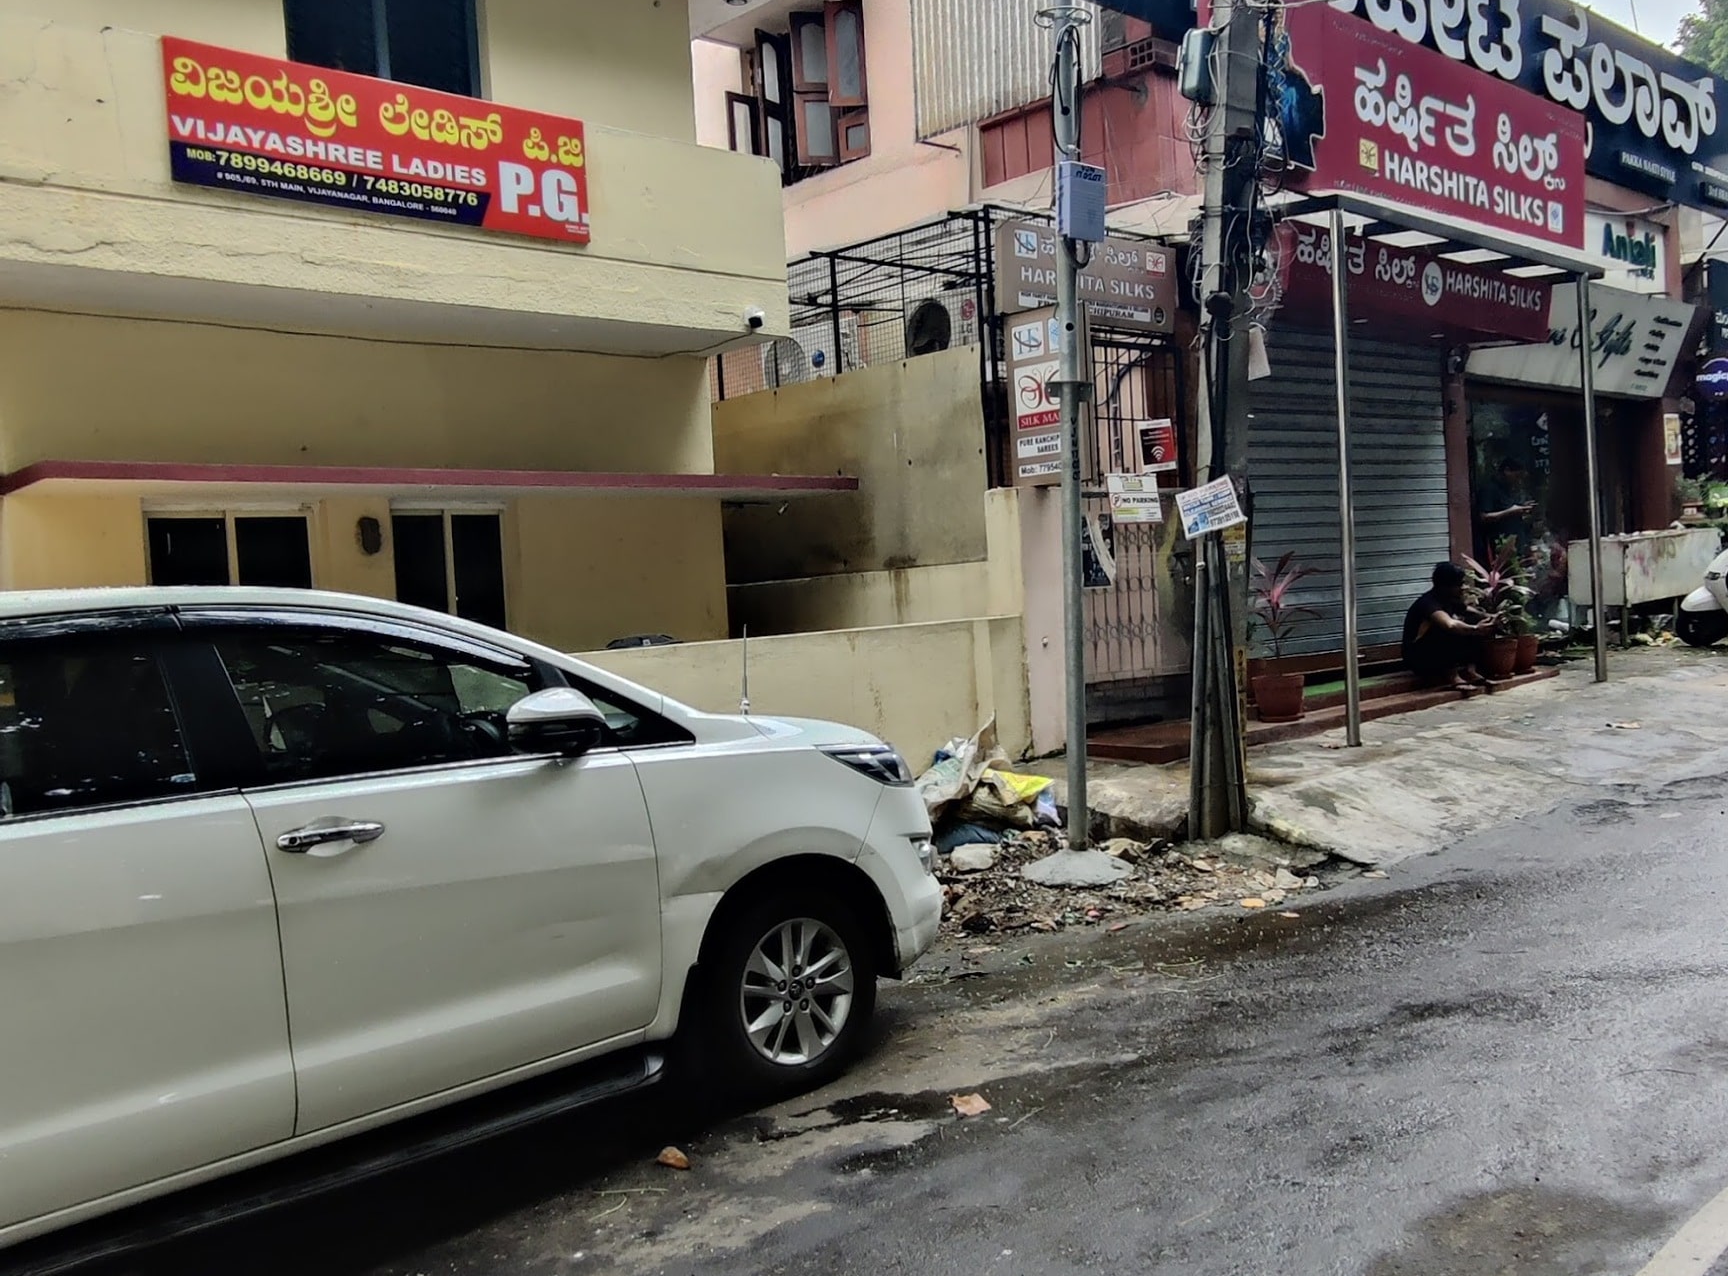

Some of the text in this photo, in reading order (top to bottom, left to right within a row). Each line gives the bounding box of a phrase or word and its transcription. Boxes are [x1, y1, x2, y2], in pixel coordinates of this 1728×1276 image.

[170, 56, 585, 168] ವಿಜಯಶ್ರೀ ಲೇಡಿಸ್ ಪಿ.ಜಿ
[1354, 57, 1477, 157] ಹರ್ಷಿತ
[171, 114, 487, 187] VIJAYASHREE LADIES
[216, 150, 347, 186] 7899468669
[363, 175, 479, 207] 7483058776
[261, 178, 279, 189] 5TH
[372, 196, 424, 211] BANGALORE
[498, 160, 590, 224] P.G.
[1384, 149, 1490, 211] HARSHITA
[1492, 185, 1546, 227] SILKS
[1021, 265, 1156, 301] HARITA SILKS
[1446, 270, 1543, 313] HARSHITA SILKS
[1042, 412, 1060, 424] MA
[1122, 496, 1159, 504] NO PARKING
